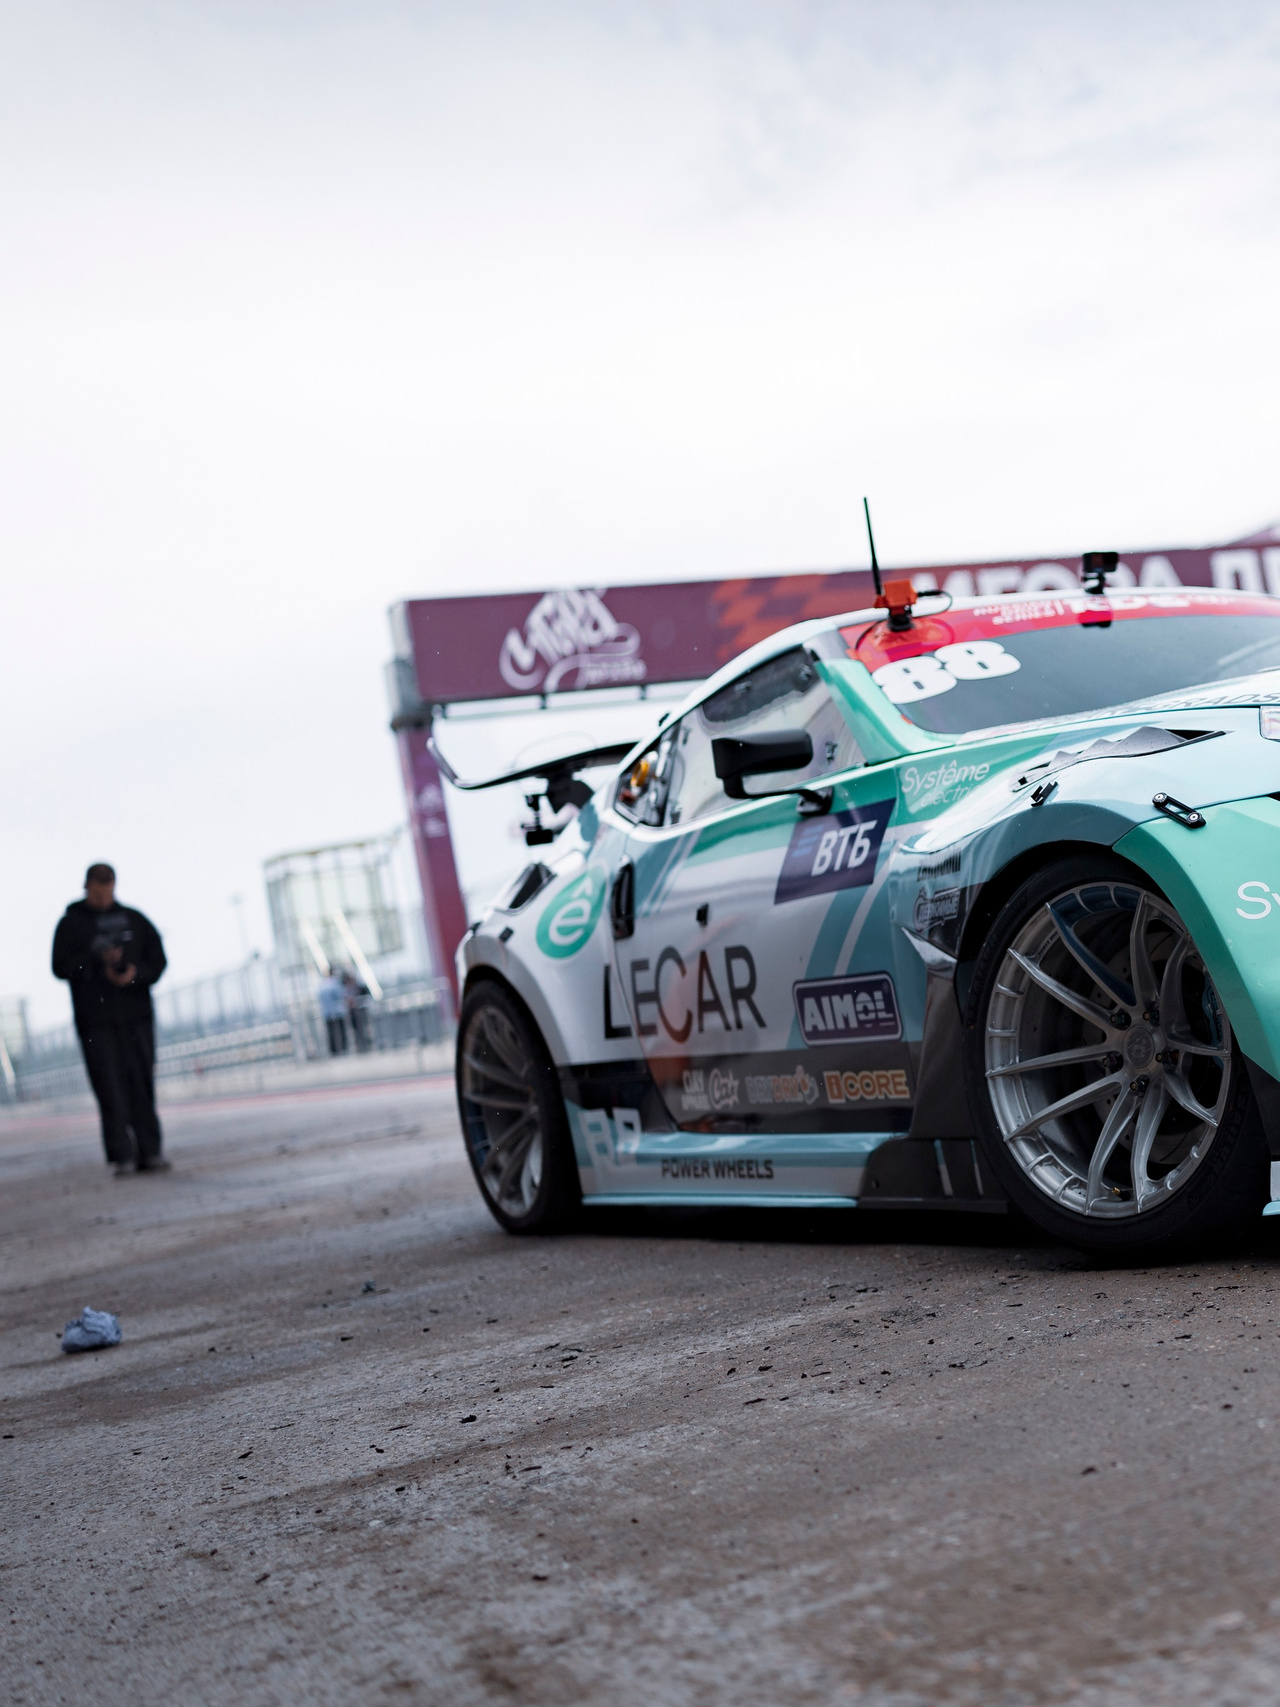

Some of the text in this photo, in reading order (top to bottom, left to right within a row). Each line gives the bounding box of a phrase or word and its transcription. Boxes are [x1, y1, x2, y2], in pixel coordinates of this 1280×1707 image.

[872, 640, 1022, 705] 88
[811, 820, 878, 877] ВТБ
[604, 944, 767, 1043] LECAR
[804, 990, 894, 1033] AIMOL
[661, 1158, 774, 1179] POWER WHEELS
